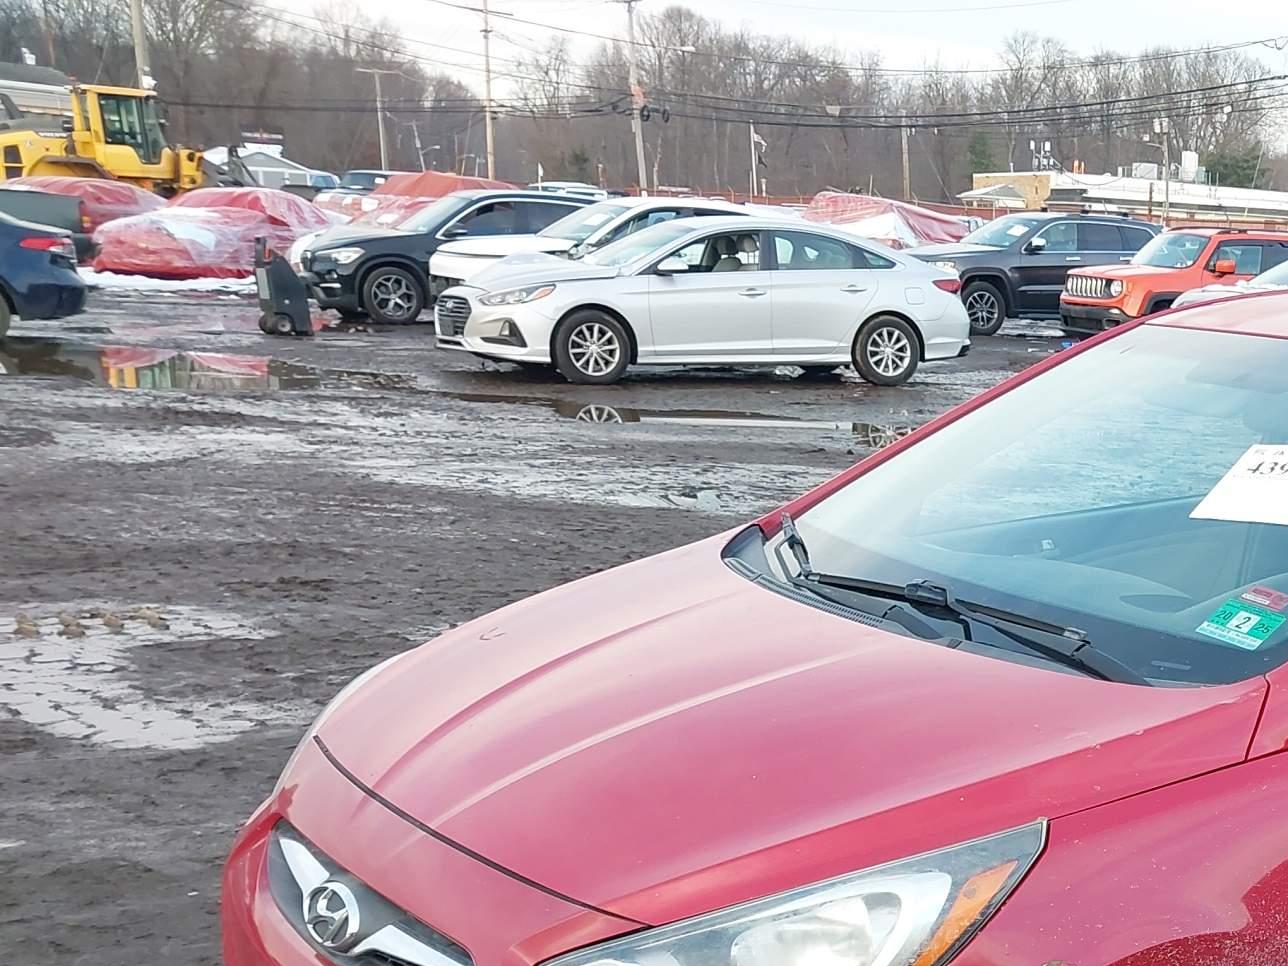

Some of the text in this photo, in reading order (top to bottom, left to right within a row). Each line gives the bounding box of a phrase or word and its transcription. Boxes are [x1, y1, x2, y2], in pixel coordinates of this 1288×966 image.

[1215, 609, 1233, 621] 20
[1235, 616, 1251, 629] 2
[1254, 622, 1273, 634] 25
